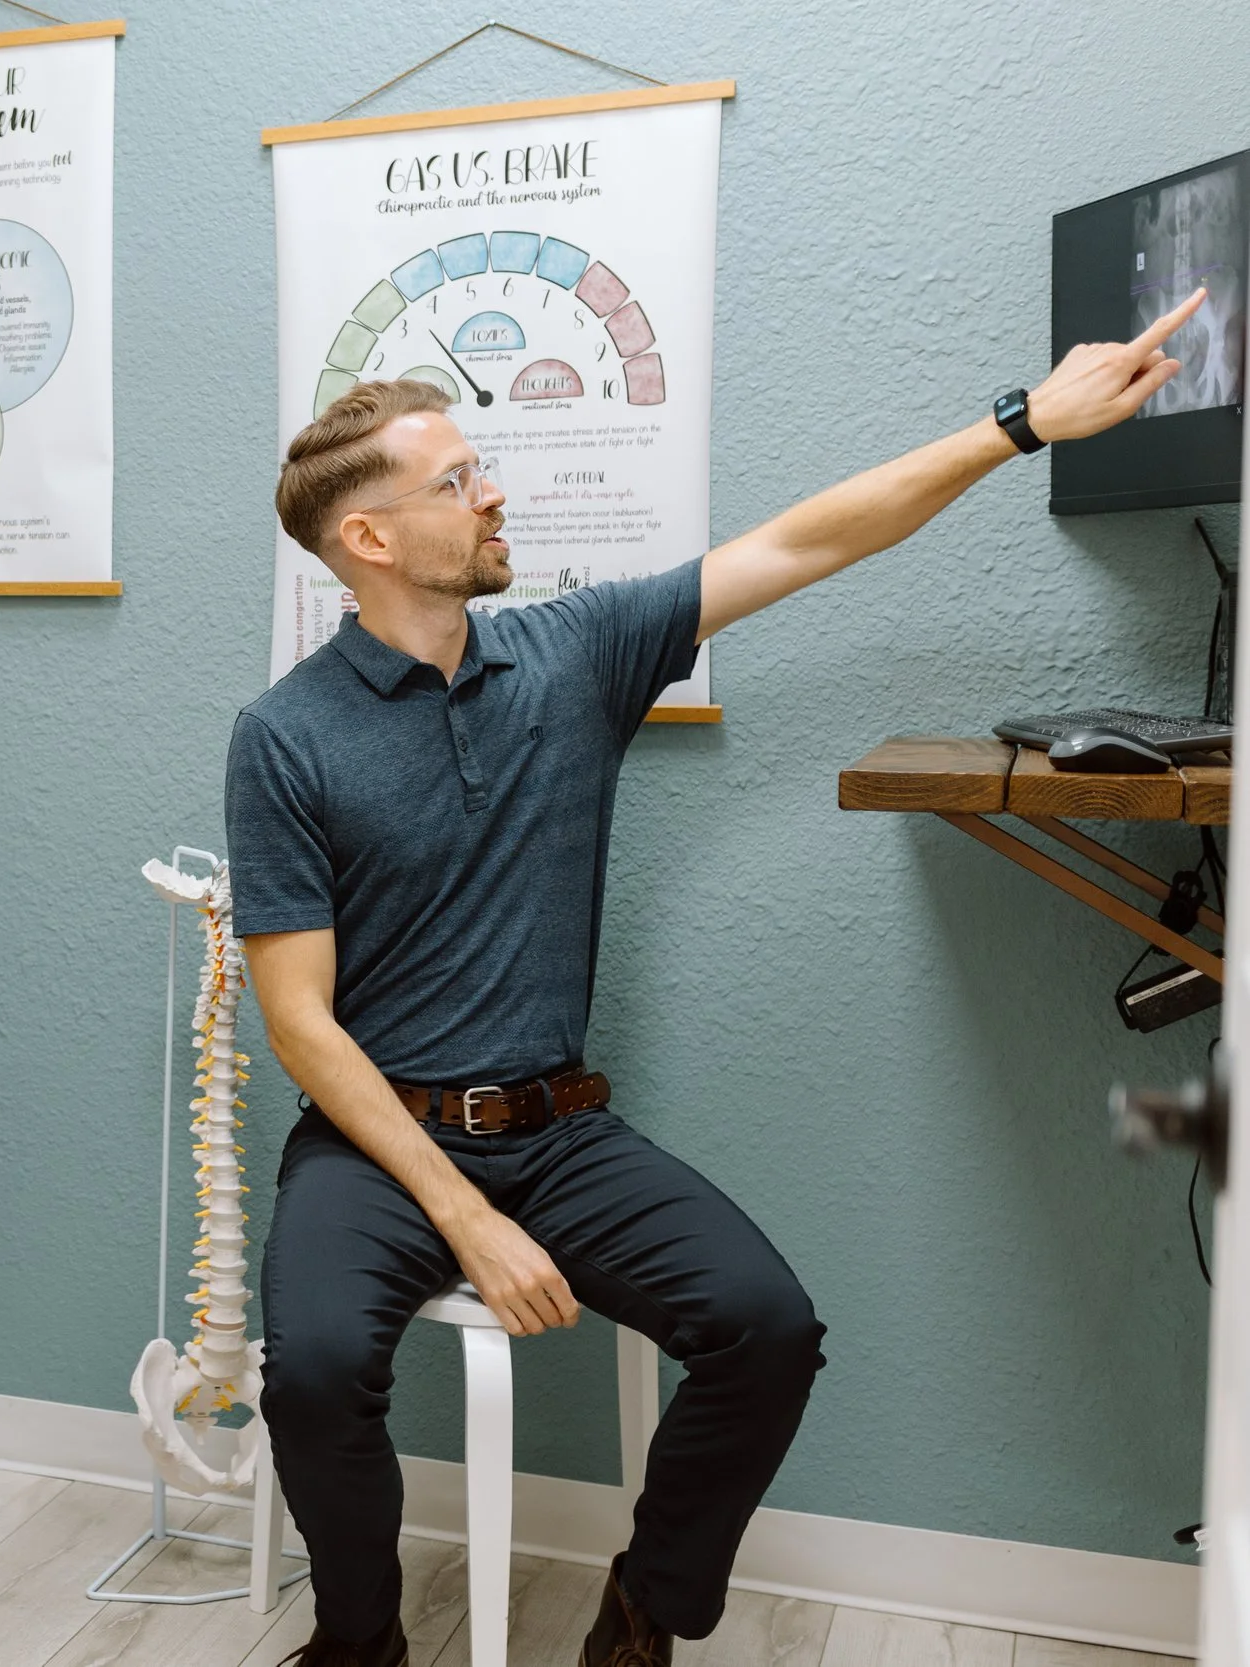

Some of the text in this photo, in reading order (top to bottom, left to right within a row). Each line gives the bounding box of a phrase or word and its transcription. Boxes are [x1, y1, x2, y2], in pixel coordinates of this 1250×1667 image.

[52, 150, 72, 167] feel
[386, 154, 443, 194] GAS
[504, 140, 600, 185] BRAKE
[376, 182, 602, 216] Chiropractic and the nervous system
[466, 281, 477, 302] 5
[502, 277, 514, 297] 6
[426, 295, 438, 315] 4
[536, 289, 551, 309] 7
[398, 319, 408, 339] 3
[574, 309, 585, 330] 8
[472, 328, 508, 343] TOXINS
[373, 352, 385, 372] 2
[465, 352, 512, 363] chemical stress
[594, 342, 606, 362] 9
[521, 376, 573, 392] THOUGHTS
[601, 378, 620, 400] 10
[522, 401, 572, 411] emotional stress
[465, 424, 637, 441] fixation within spine creates stress and tension
[477, 443, 502, 455] System
[523, 442, 536, 451] into
[544, 440, 577, 453] protective
[579, 440, 597, 449] state
[609, 437, 624, 449] fight
[554, 470, 605, 484] GAS PEDAL
[529, 490, 572, 505] sympathetic
[614, 488, 635, 502] cycle
[507, 507, 654, 521] Misalignments and fixation occur (subluxation)
[526, 524, 551, 532] Nervous
[553, 523, 577, 534] System
[578, 522, 592, 533] gets
[593, 520, 610, 531] stuck
[621, 520, 635, 531] fight
[645, 520, 662, 531] flight
[513, 533, 646, 547] Stress response (adrenal glands activated)
[558, 567, 581, 596] flu
[295, 574, 305, 661] Sinus congestion
